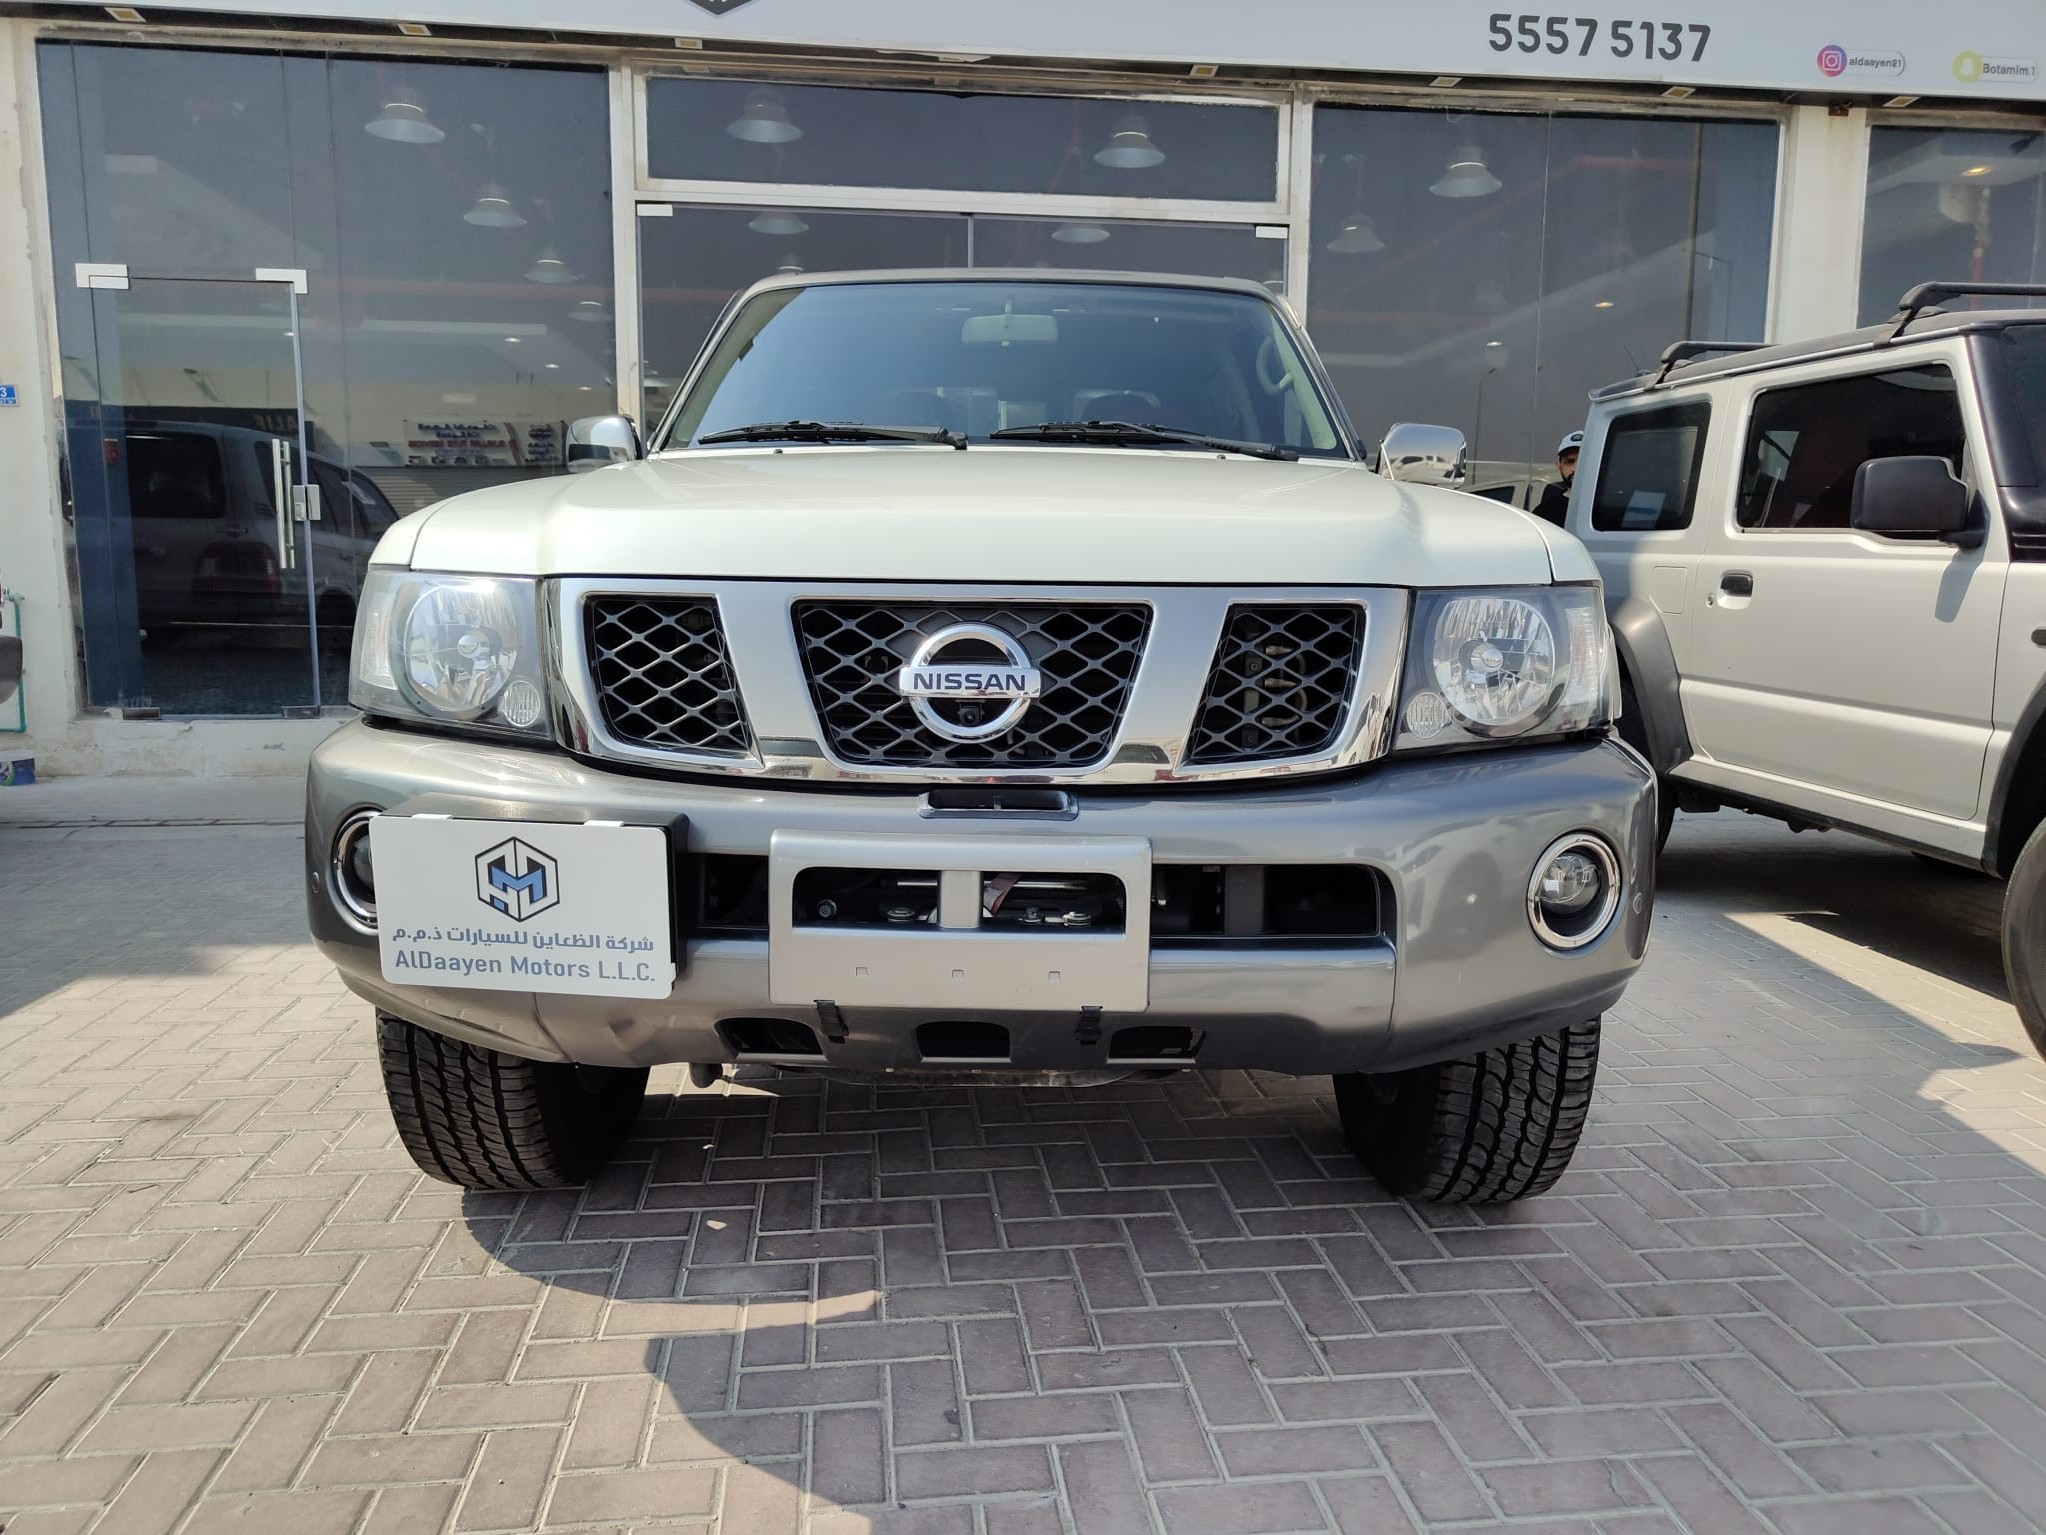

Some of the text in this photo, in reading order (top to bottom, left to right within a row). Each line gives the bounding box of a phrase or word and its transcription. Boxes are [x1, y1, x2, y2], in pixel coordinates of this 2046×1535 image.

[1488, 13, 1712, 62] 5557 5137
[914, 673, 1026, 691] NISSAN
[446, 926, 528, 946] للسيارات
[532, 932, 601, 949] الظعاين
[605, 937, 654, 954] شركة
[394, 949, 655, 982] AlDaayen Motors L.L.C.
